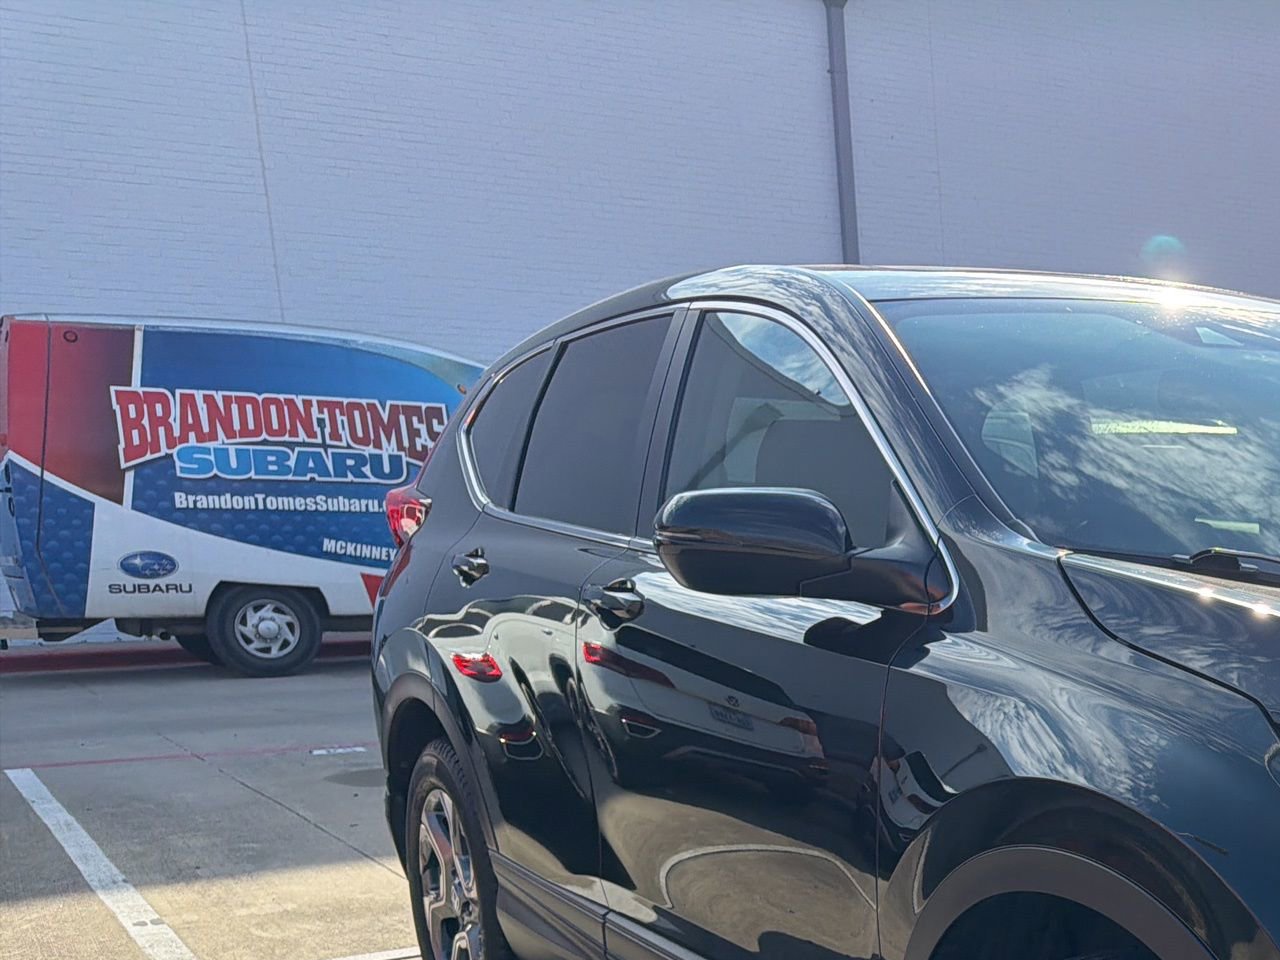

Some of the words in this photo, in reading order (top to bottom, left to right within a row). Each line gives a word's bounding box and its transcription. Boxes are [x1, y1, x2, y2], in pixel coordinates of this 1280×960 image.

[112, 387, 319, 467] BRANDON
[174, 444, 404, 484] SUBARU
[323, 537, 397, 561] MCKINNEY
[108, 583, 193, 594] SUBARU
